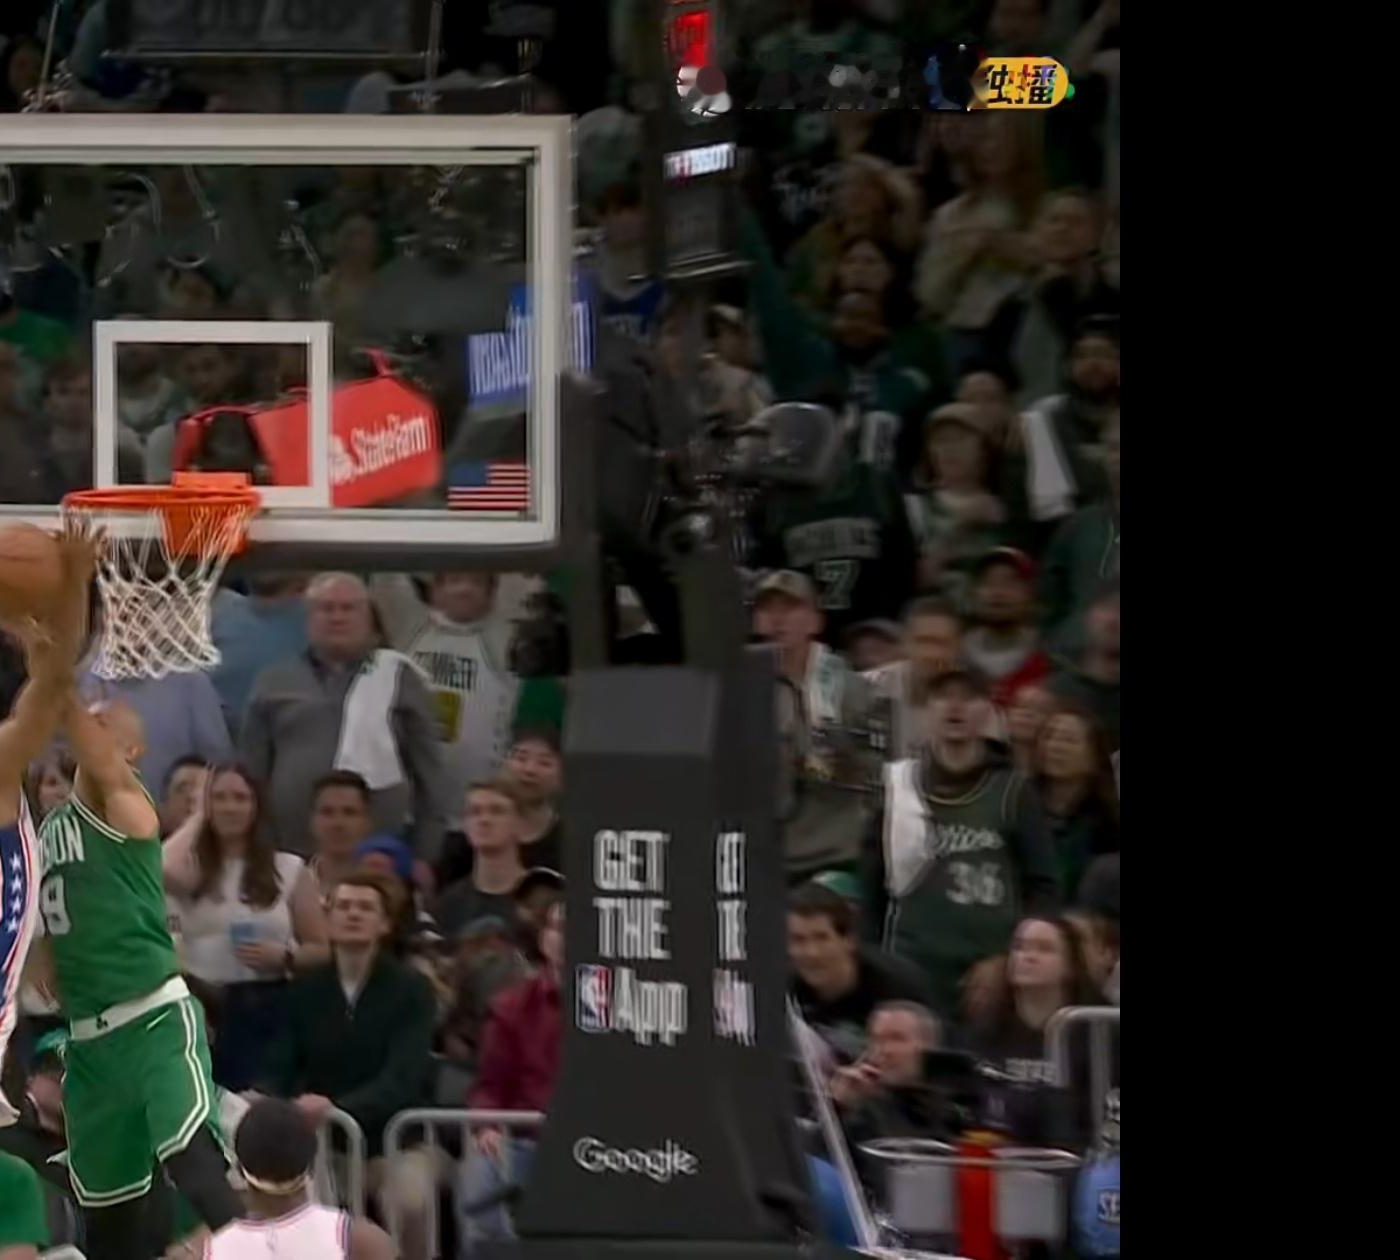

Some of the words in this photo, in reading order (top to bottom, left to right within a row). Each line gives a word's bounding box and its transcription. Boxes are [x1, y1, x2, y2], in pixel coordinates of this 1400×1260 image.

[593, 829, 671, 892] GET
[592, 896, 672, 960] THE
[613, 965, 688, 1047] App
[572, 1134, 700, 1184] Google
